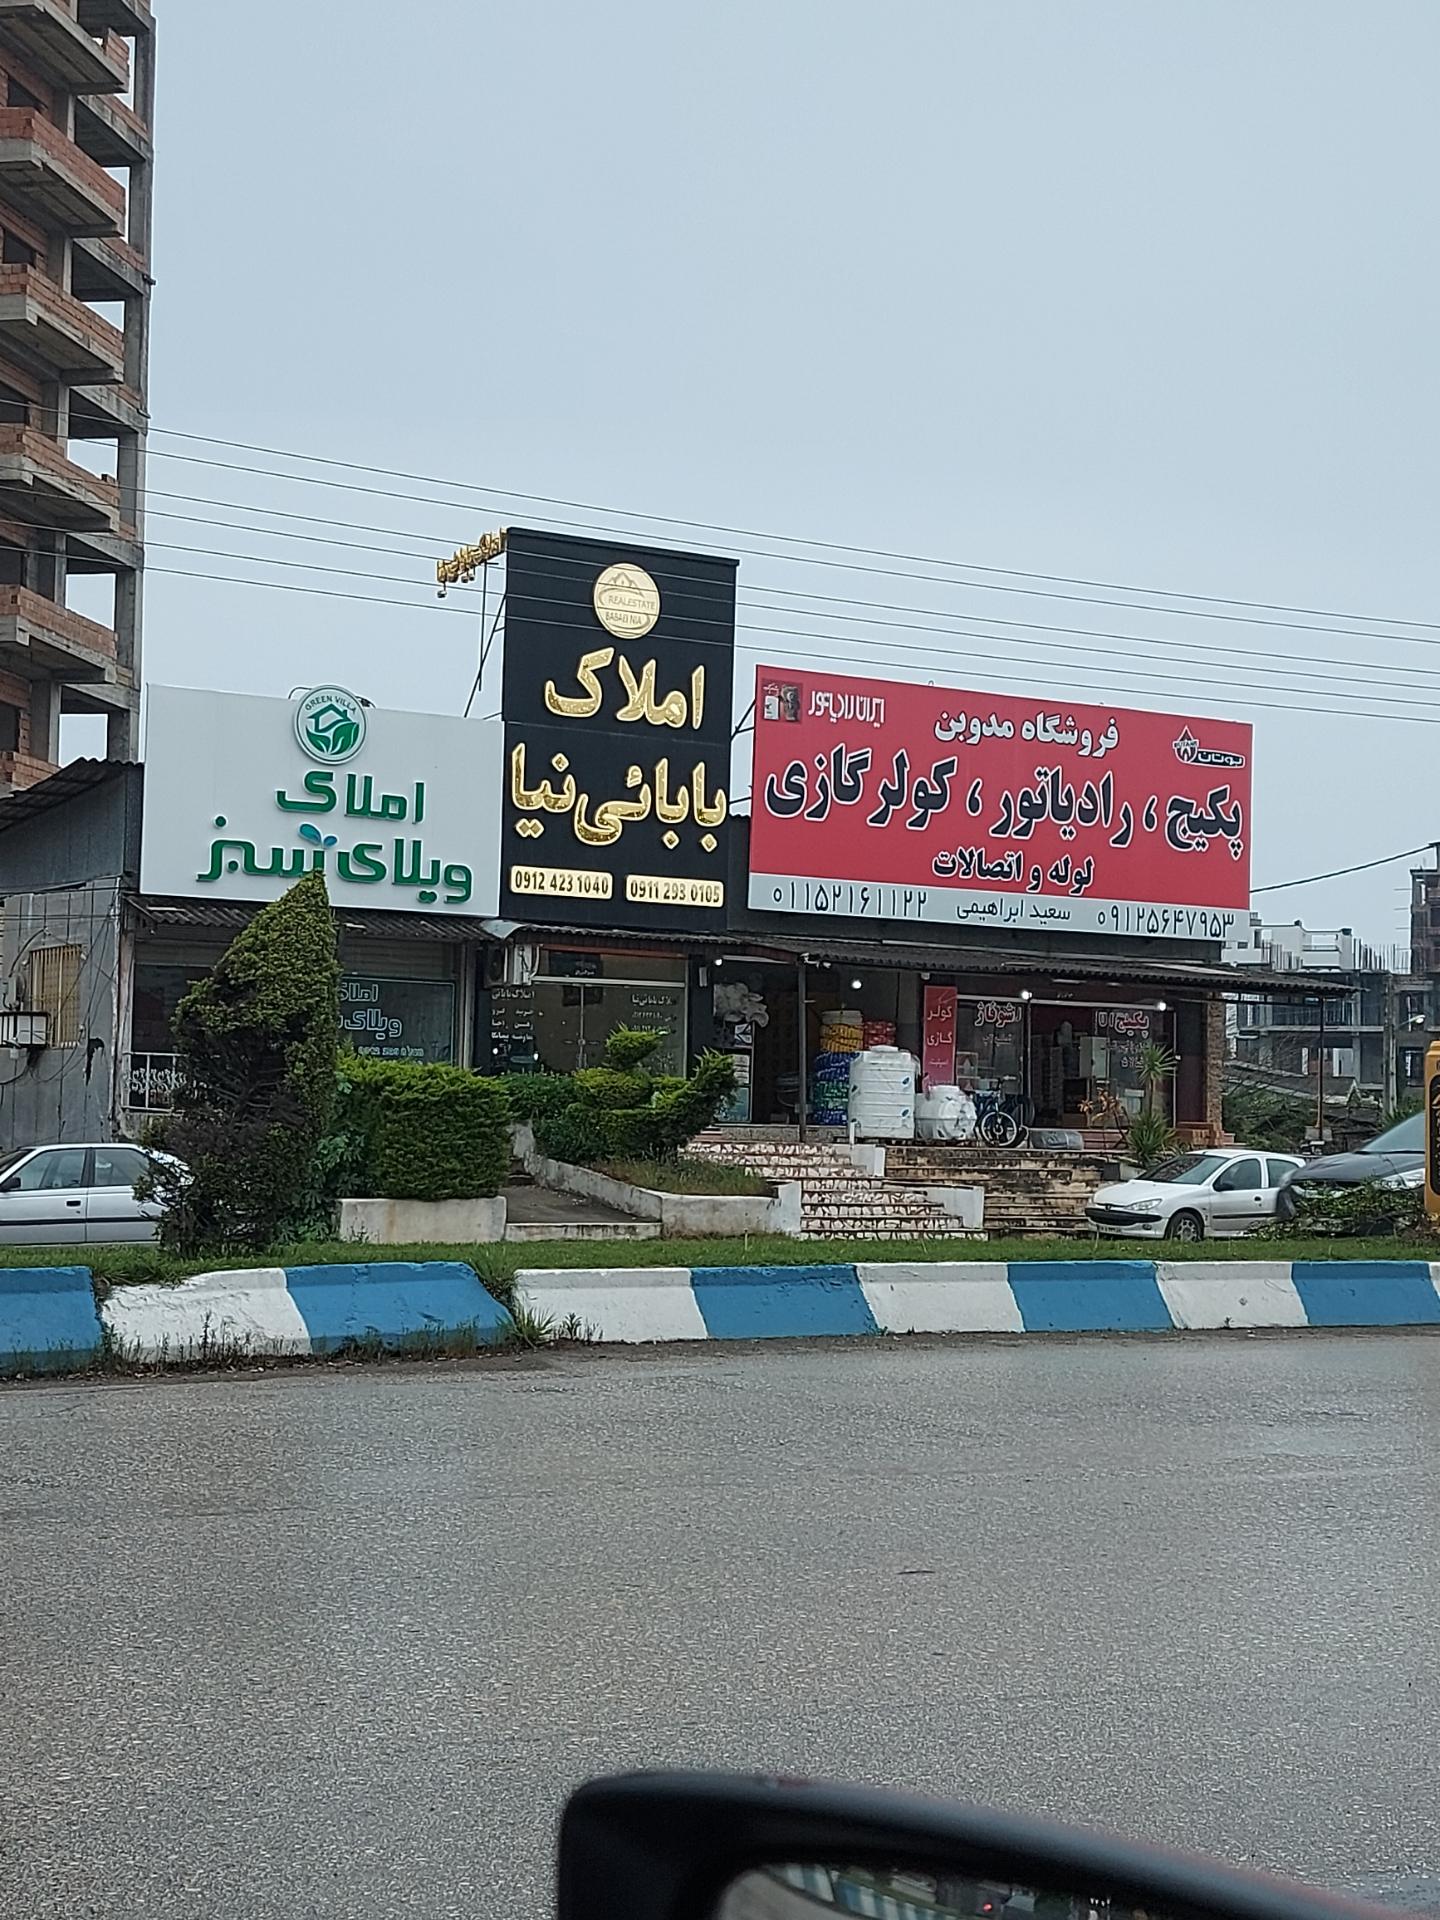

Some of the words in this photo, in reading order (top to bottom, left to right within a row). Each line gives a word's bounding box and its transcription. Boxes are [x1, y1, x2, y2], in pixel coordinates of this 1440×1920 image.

[305, 695, 333, 711] GREEN
[334, 695, 356, 715] VILLA
[544, 647, 704, 730] املاک
[1021, 710, 1121, 758] فروشگاه
[1198, 752, 1243, 768] بوتان
[276, 769, 425, 824] املاک
[764, 743, 872, 822] گازی
[866, 749, 959, 829] کولر
[988, 765, 1134, 848] رادیاتور
[1164, 784, 1245, 862] پکیج
[196, 815, 327, 883] سبز
[931, 846, 1024, 882] اتصالات
[337, 837, 474, 905] ویلای
[515, 869, 545, 891] 0912
[549, 874, 574, 894] 423
[577, 876, 610, 896] 1040
[1026, 865, 1044, 893] و
[1048, 854, 1095, 896] لوله
[630, 879, 660, 899] 0911
[773, 880, 928, 918] ۰۱۱۵۲۱۶۱۱۲۲
[957, 898, 1025, 923] ابراهیمی
[1029, 903, 1071, 925] سعید
[1097, 904, 1235, 938] ۰۹۱۲۵۶۴۷۹۵۳
[927, 1003, 953, 1021] کولر
[974, 1001, 1016, 1028] شوفاژ
[1115, 1010, 1150, 1039] پکیج
[927, 1030, 953, 1047] گازی
